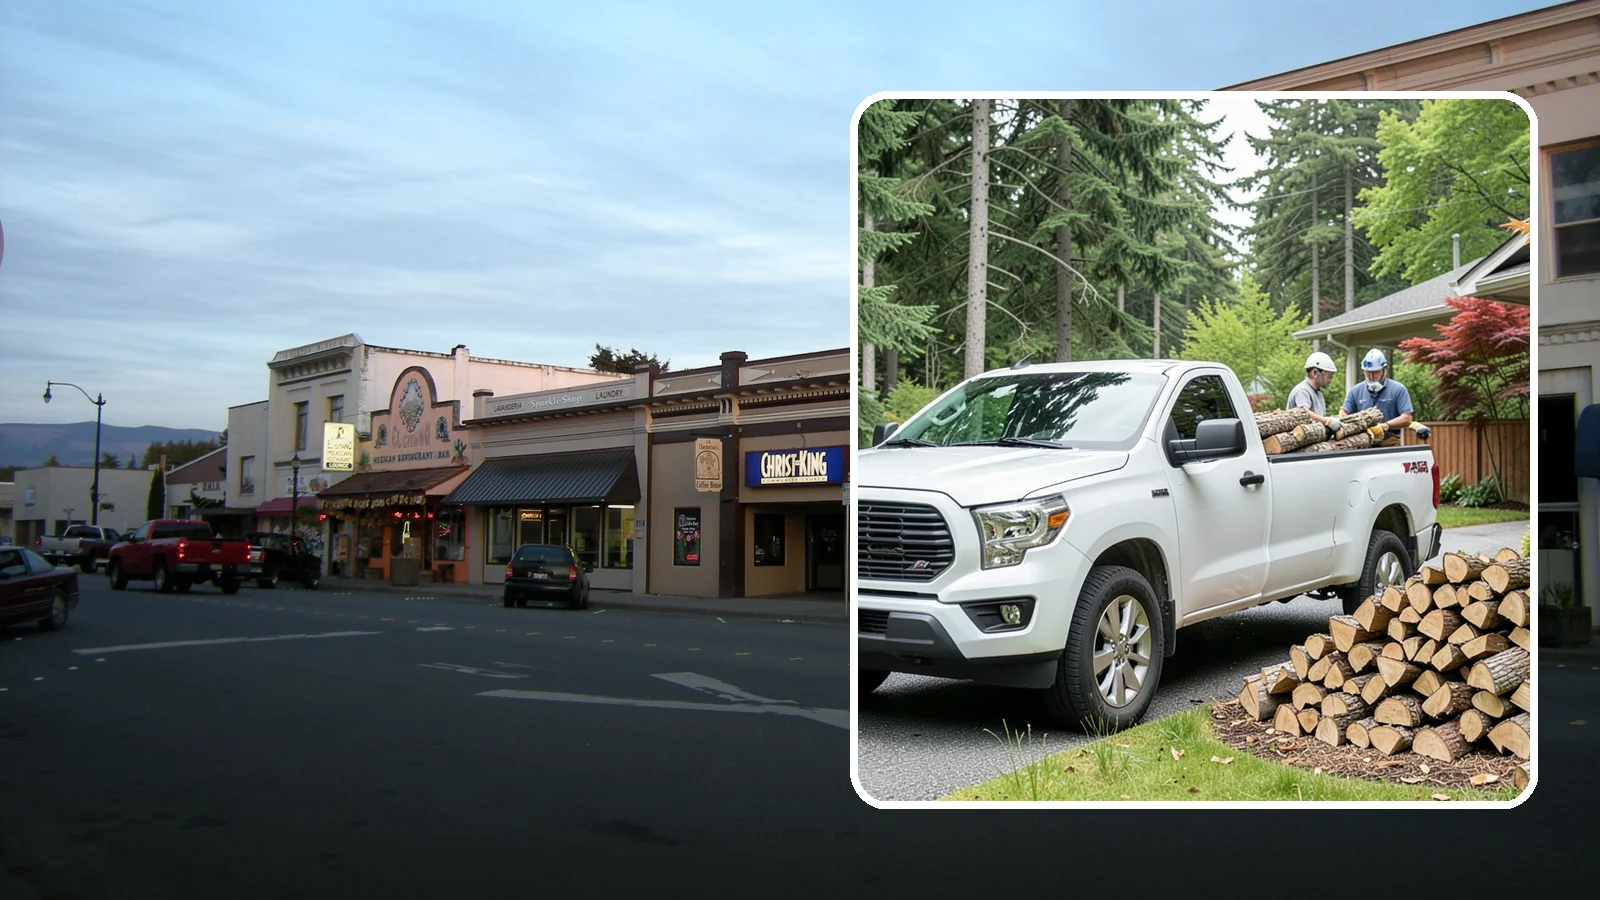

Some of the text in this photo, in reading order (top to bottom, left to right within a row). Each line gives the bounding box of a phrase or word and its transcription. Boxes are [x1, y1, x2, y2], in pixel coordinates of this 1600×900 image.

[562, 394, 583, 404] Shop
[595, 388, 623, 400] LAUNDRY
[493, 402, 522, 412] LAVANDERIA
[373, 454, 396, 464] MEXICAN
[397, 451, 433, 462] RESTAURANT
[437, 450, 450, 459] BAR
[761, 450, 828, 478] CHRIST KING
[696, 481, 722, 489] Coffee House
